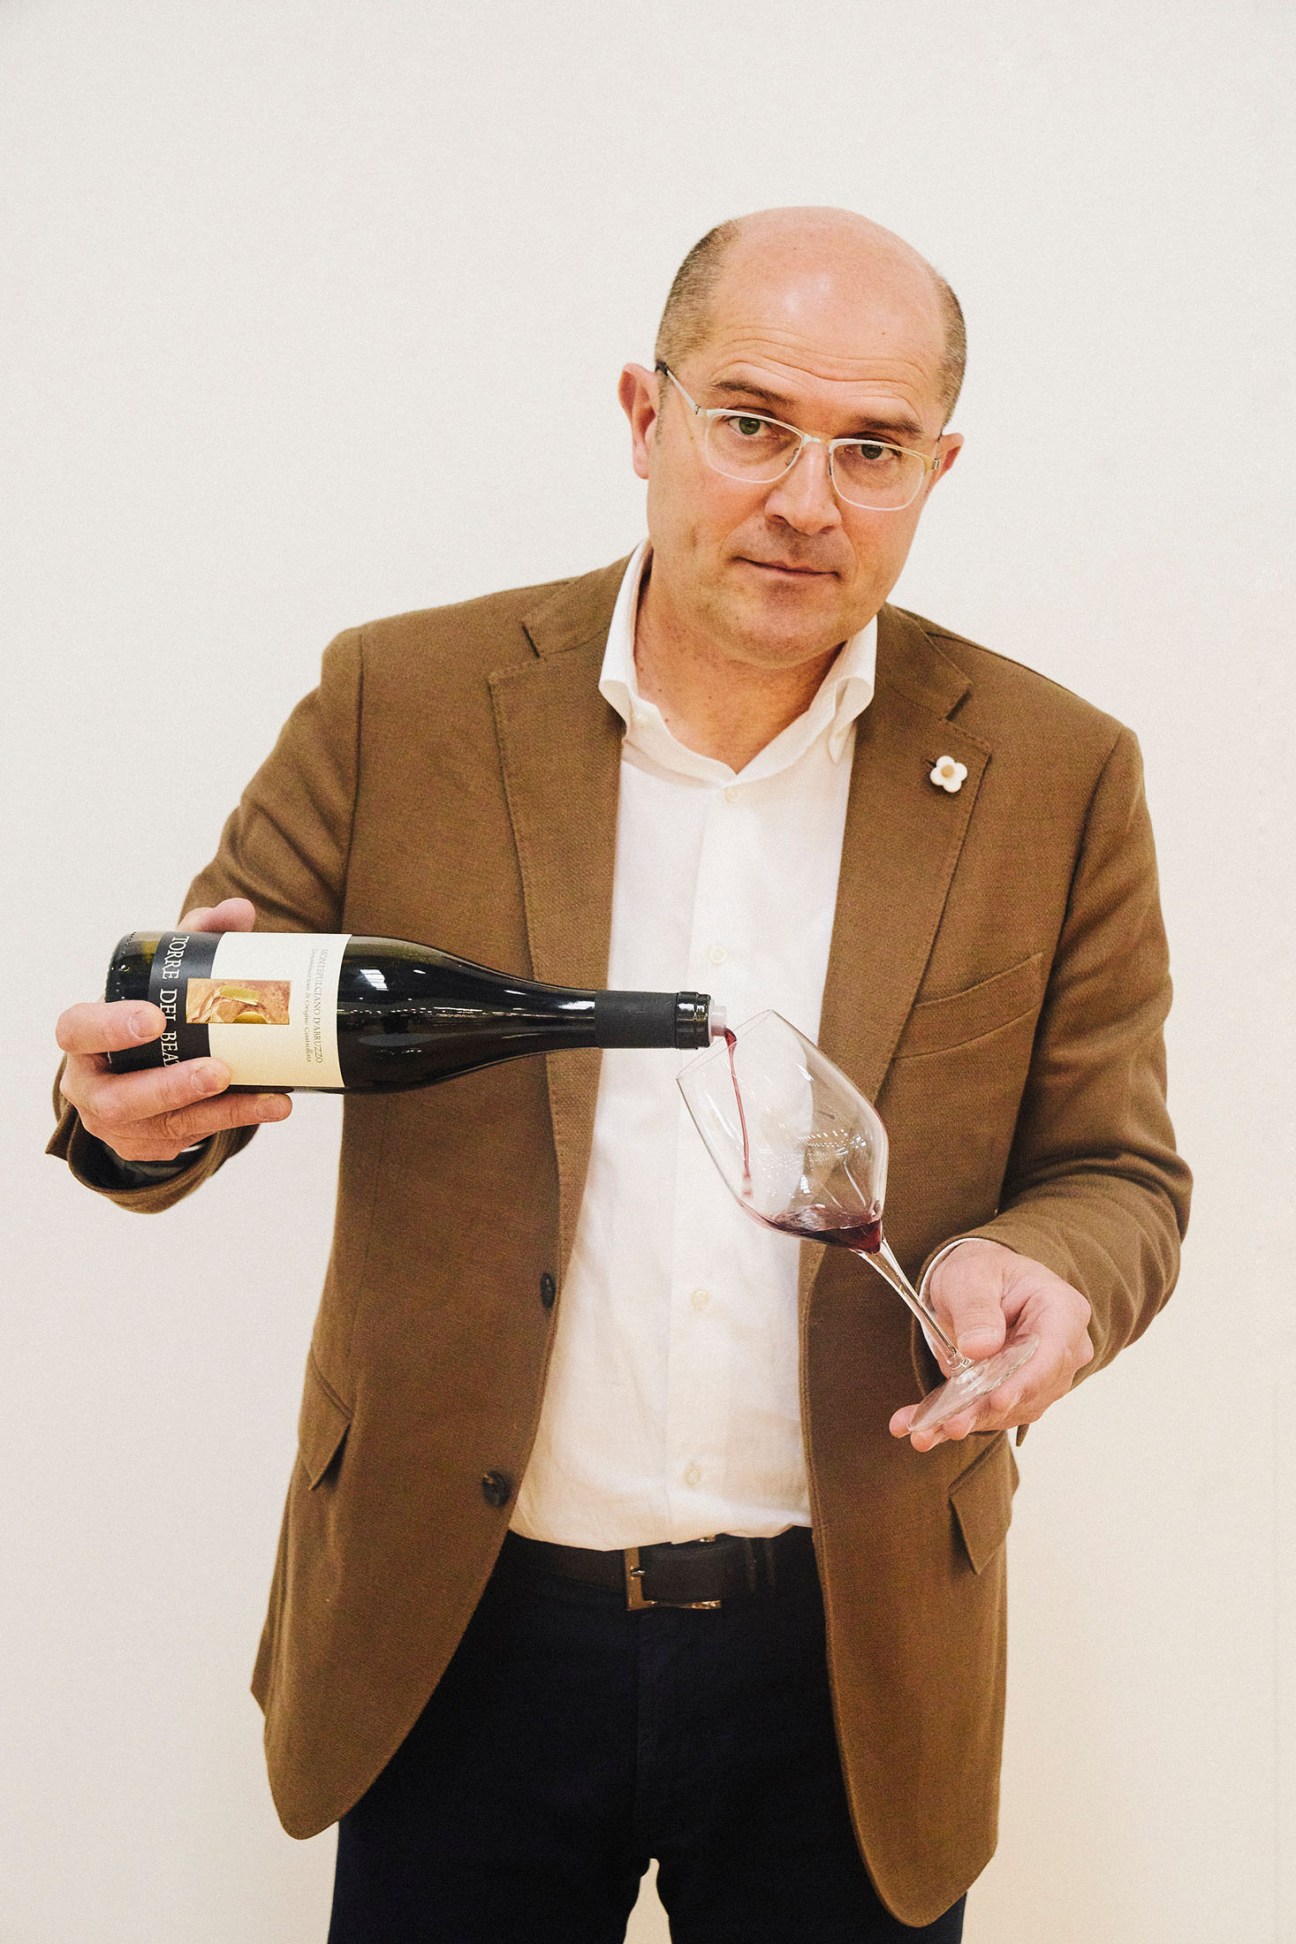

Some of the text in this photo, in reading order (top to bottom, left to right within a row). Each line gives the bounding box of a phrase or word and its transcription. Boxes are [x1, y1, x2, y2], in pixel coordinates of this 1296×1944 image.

[162, 936, 190, 980] TORRE
[313, 949, 328, 1064] MONTEPULCIANO D'ABRUZZO
